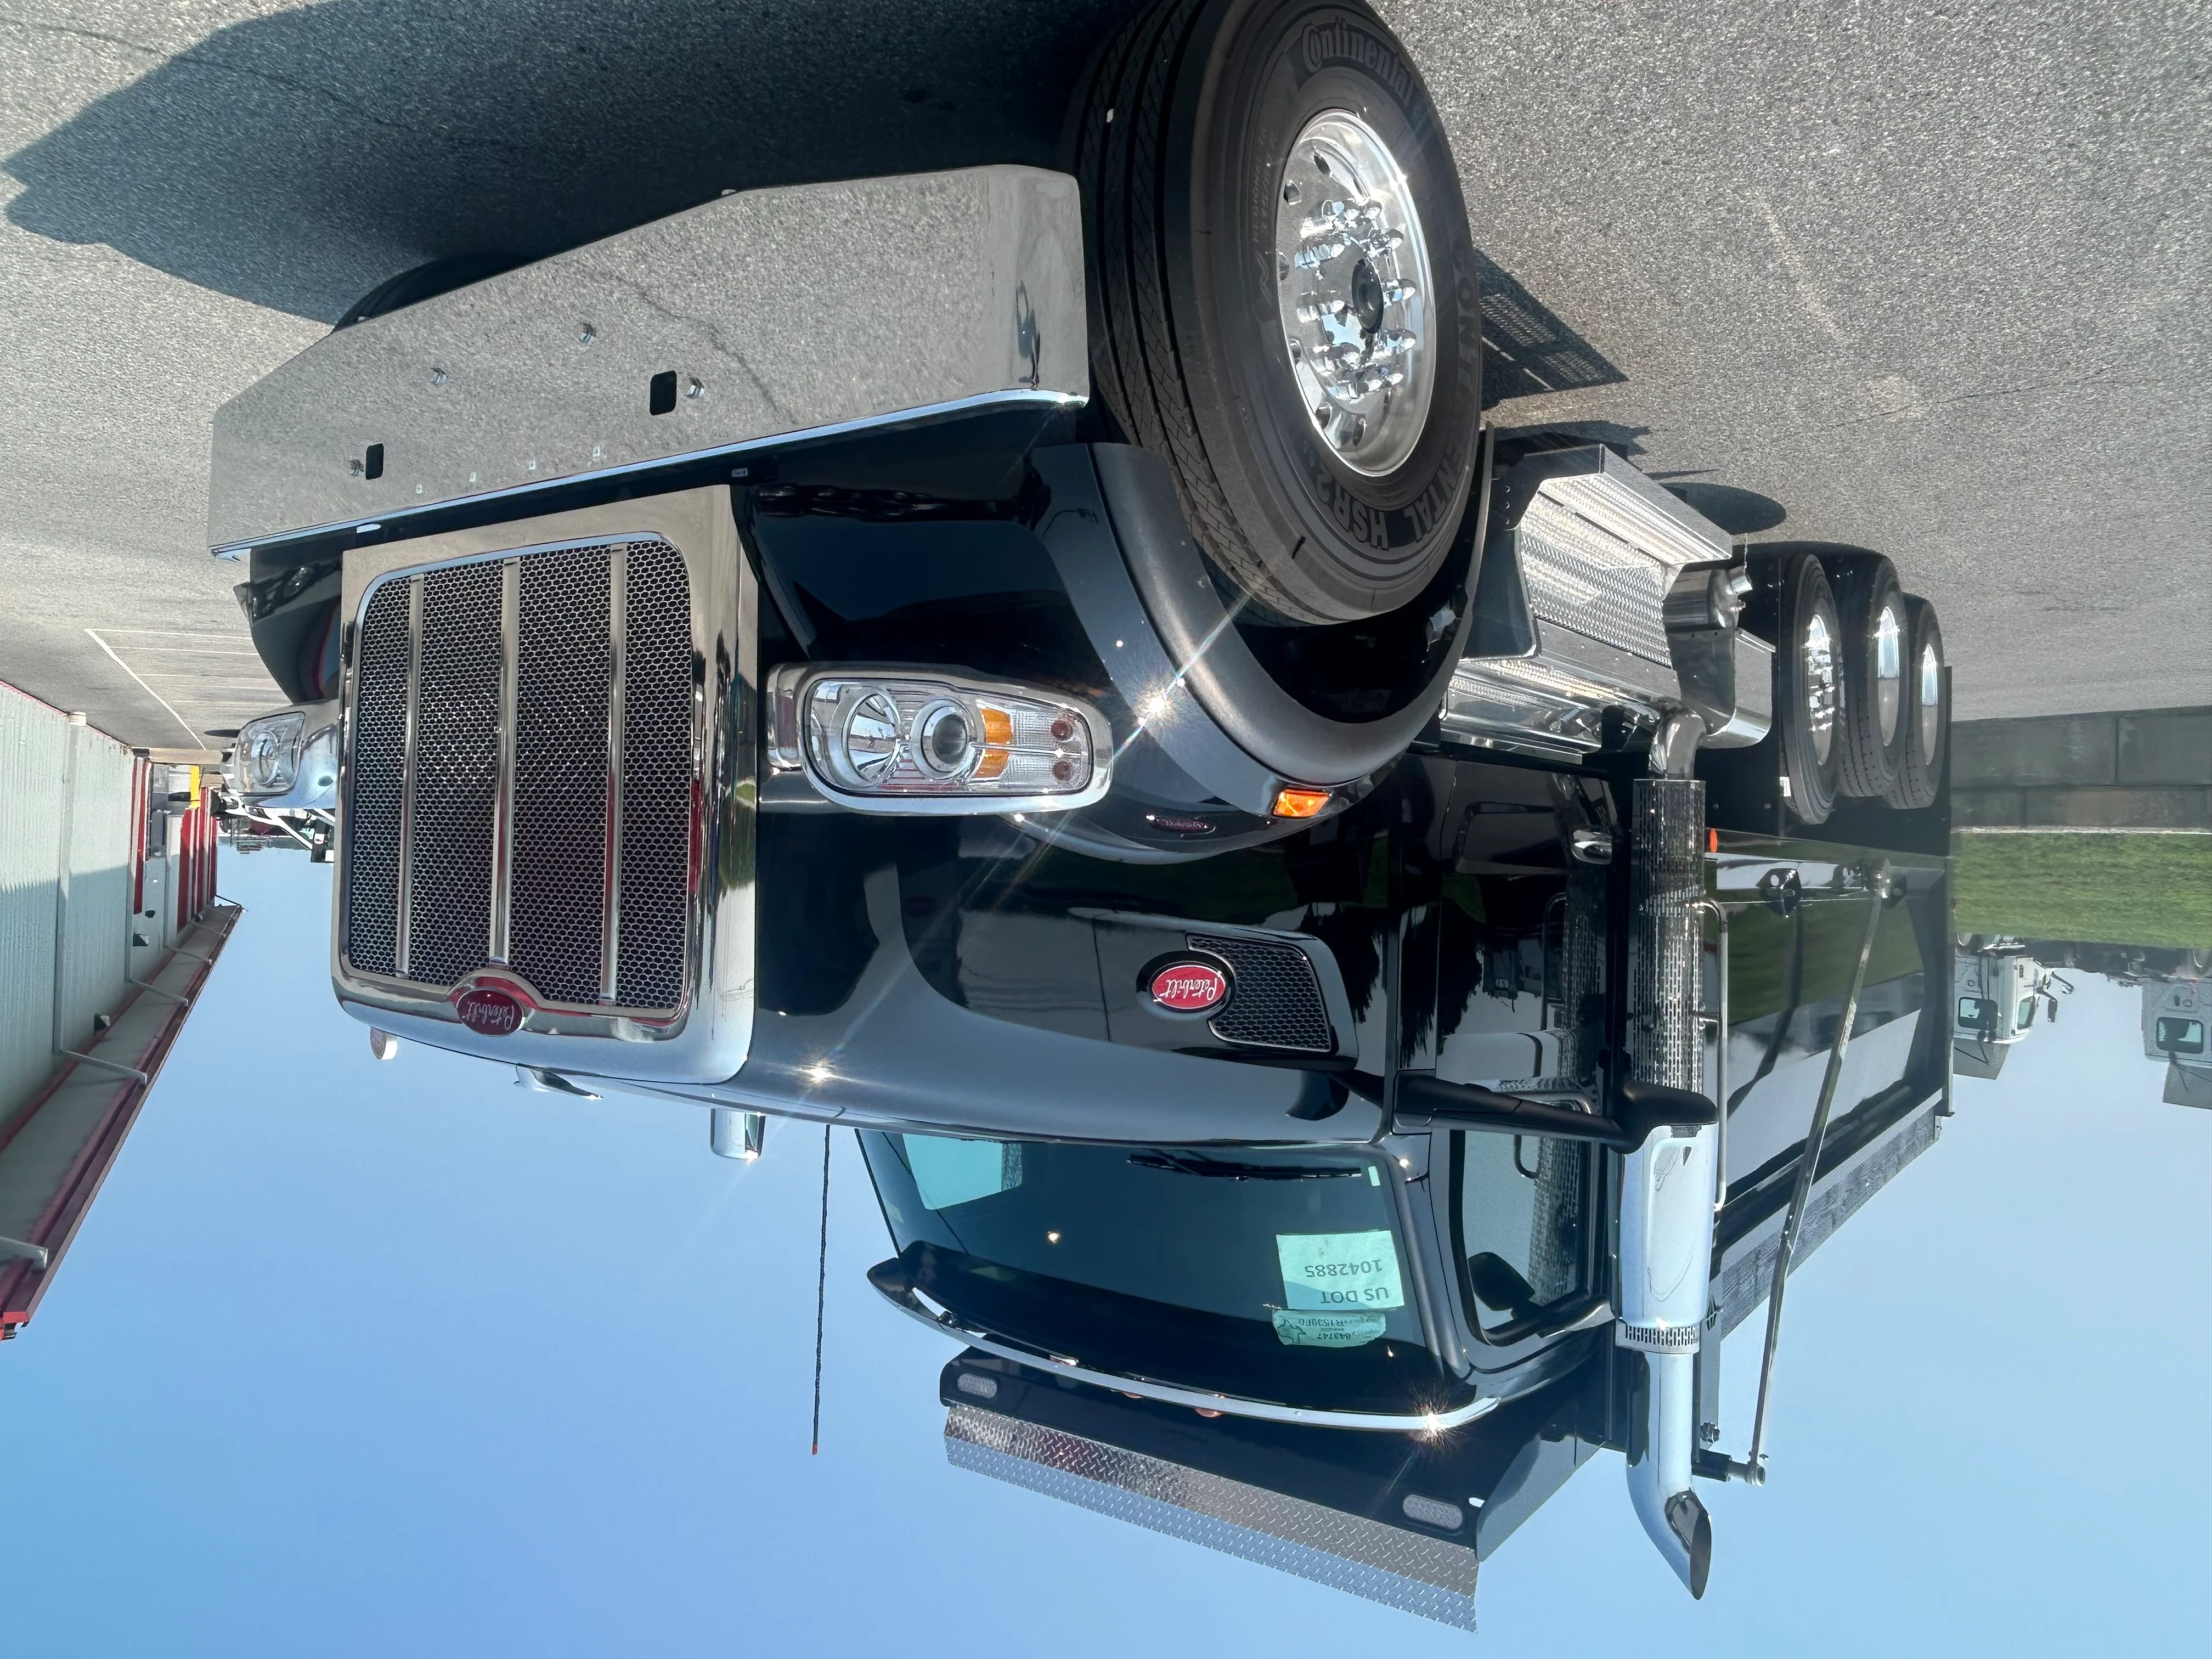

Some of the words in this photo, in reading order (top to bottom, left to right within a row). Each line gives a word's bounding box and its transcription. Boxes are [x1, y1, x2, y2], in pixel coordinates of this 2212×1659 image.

[1302, 16, 1413, 107] Continental
[1159, 977, 1217, 1001] Peterbilt
[461, 1001, 515, 1030] Peterbilt
[1304, 1260, 1383, 1277] 1042885
[1321, 1290, 1358, 1304] DOT
[1363, 1287, 1389, 1301] US
